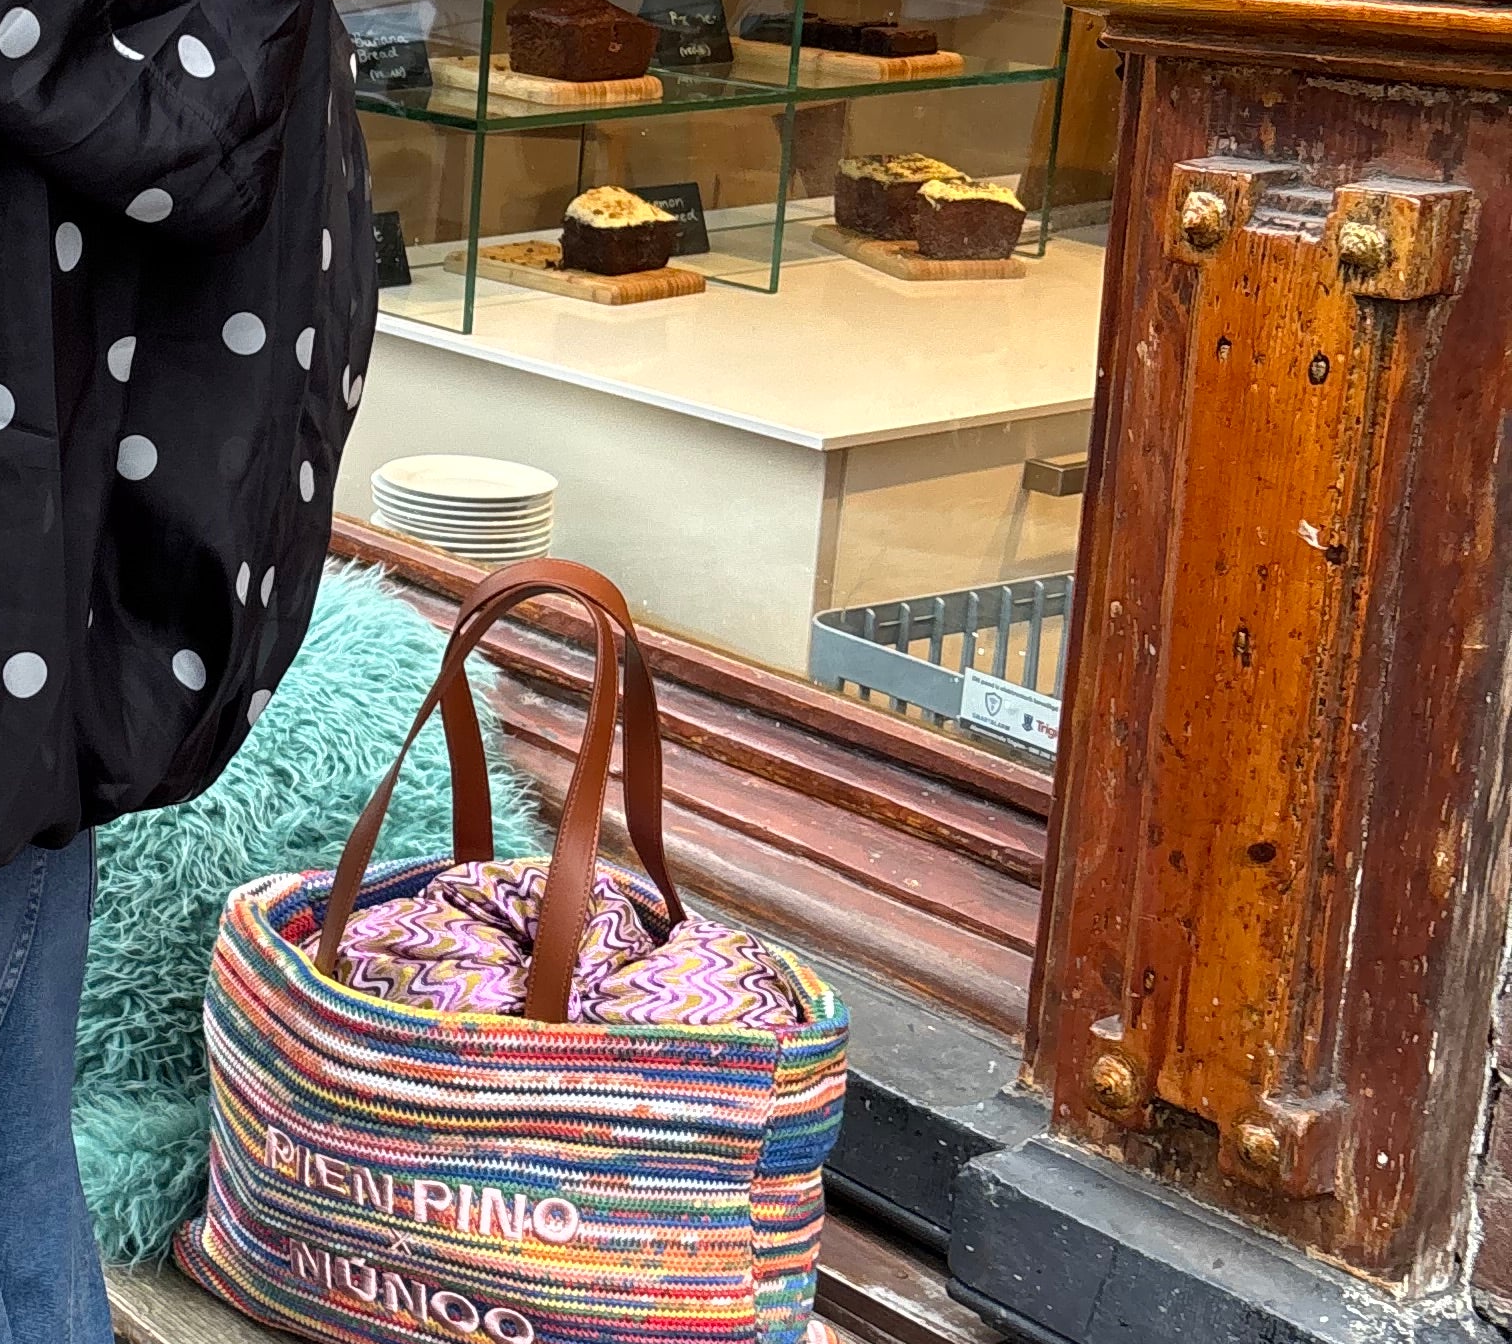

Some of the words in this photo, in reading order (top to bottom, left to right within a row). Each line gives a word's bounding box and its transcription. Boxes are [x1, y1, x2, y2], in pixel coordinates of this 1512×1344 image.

[357, 45, 400, 64] Bread
[1036, 720, 1058, 739] Trig
[264, 1124, 394, 1215] PIEN
[413, 1179, 579, 1244] PINO
